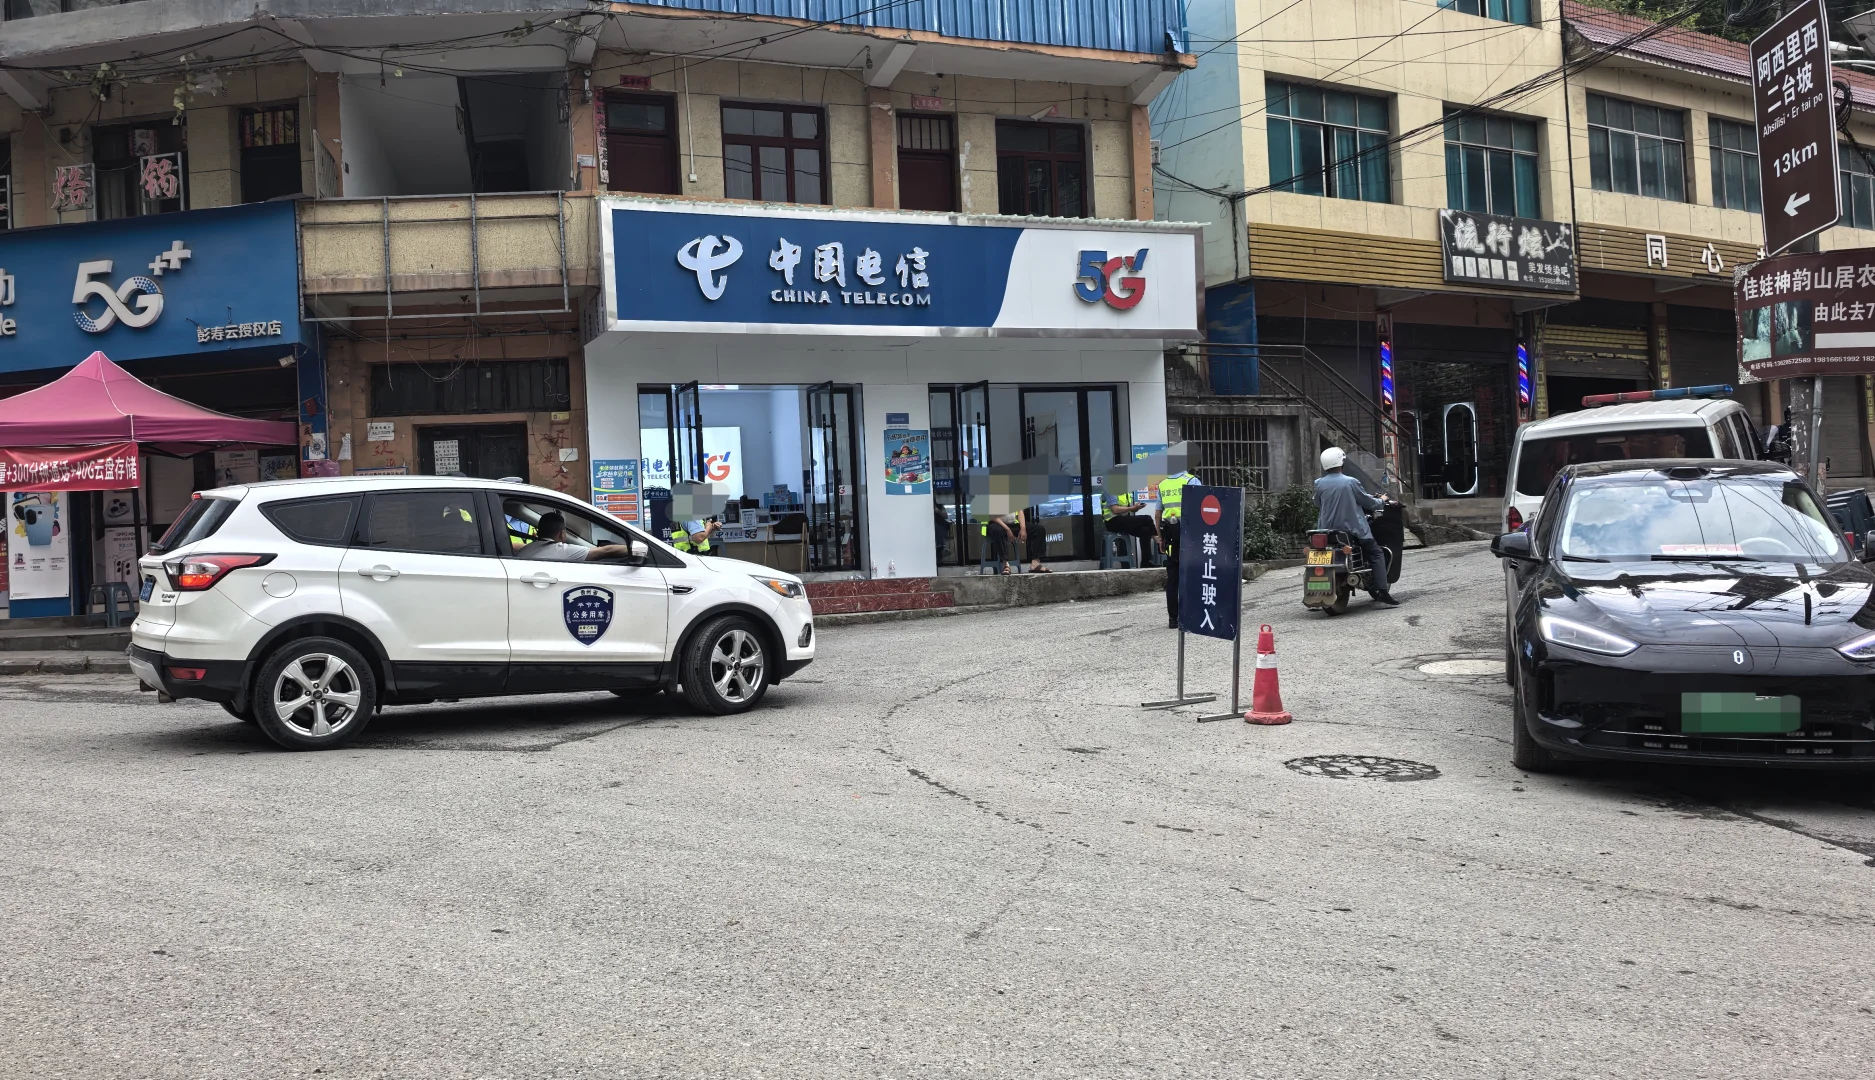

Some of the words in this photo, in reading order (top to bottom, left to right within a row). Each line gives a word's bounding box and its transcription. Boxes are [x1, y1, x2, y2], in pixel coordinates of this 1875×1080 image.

[1757, 18, 1818, 87] 阿西里西
[1767, 61, 1813, 113] 二台坡
[1791, 105, 1800, 119] Er
[1801, 97, 1811, 112] tai
[1813, 92, 1823, 108] po
[1773, 141, 1818, 178] 13km
[769, 237, 930, 289] 中国电信
[1073, 247, 1149, 311] 5G
[1742, 263, 1875, 301] 佳娃神韵山居农
[770, 289, 832, 304] CHINA
[841, 290, 932, 306] TELECOM
[196, 320, 282, 343] 彭寿云授权店
[1200, 532, 1219, 631] 禁止驶入
